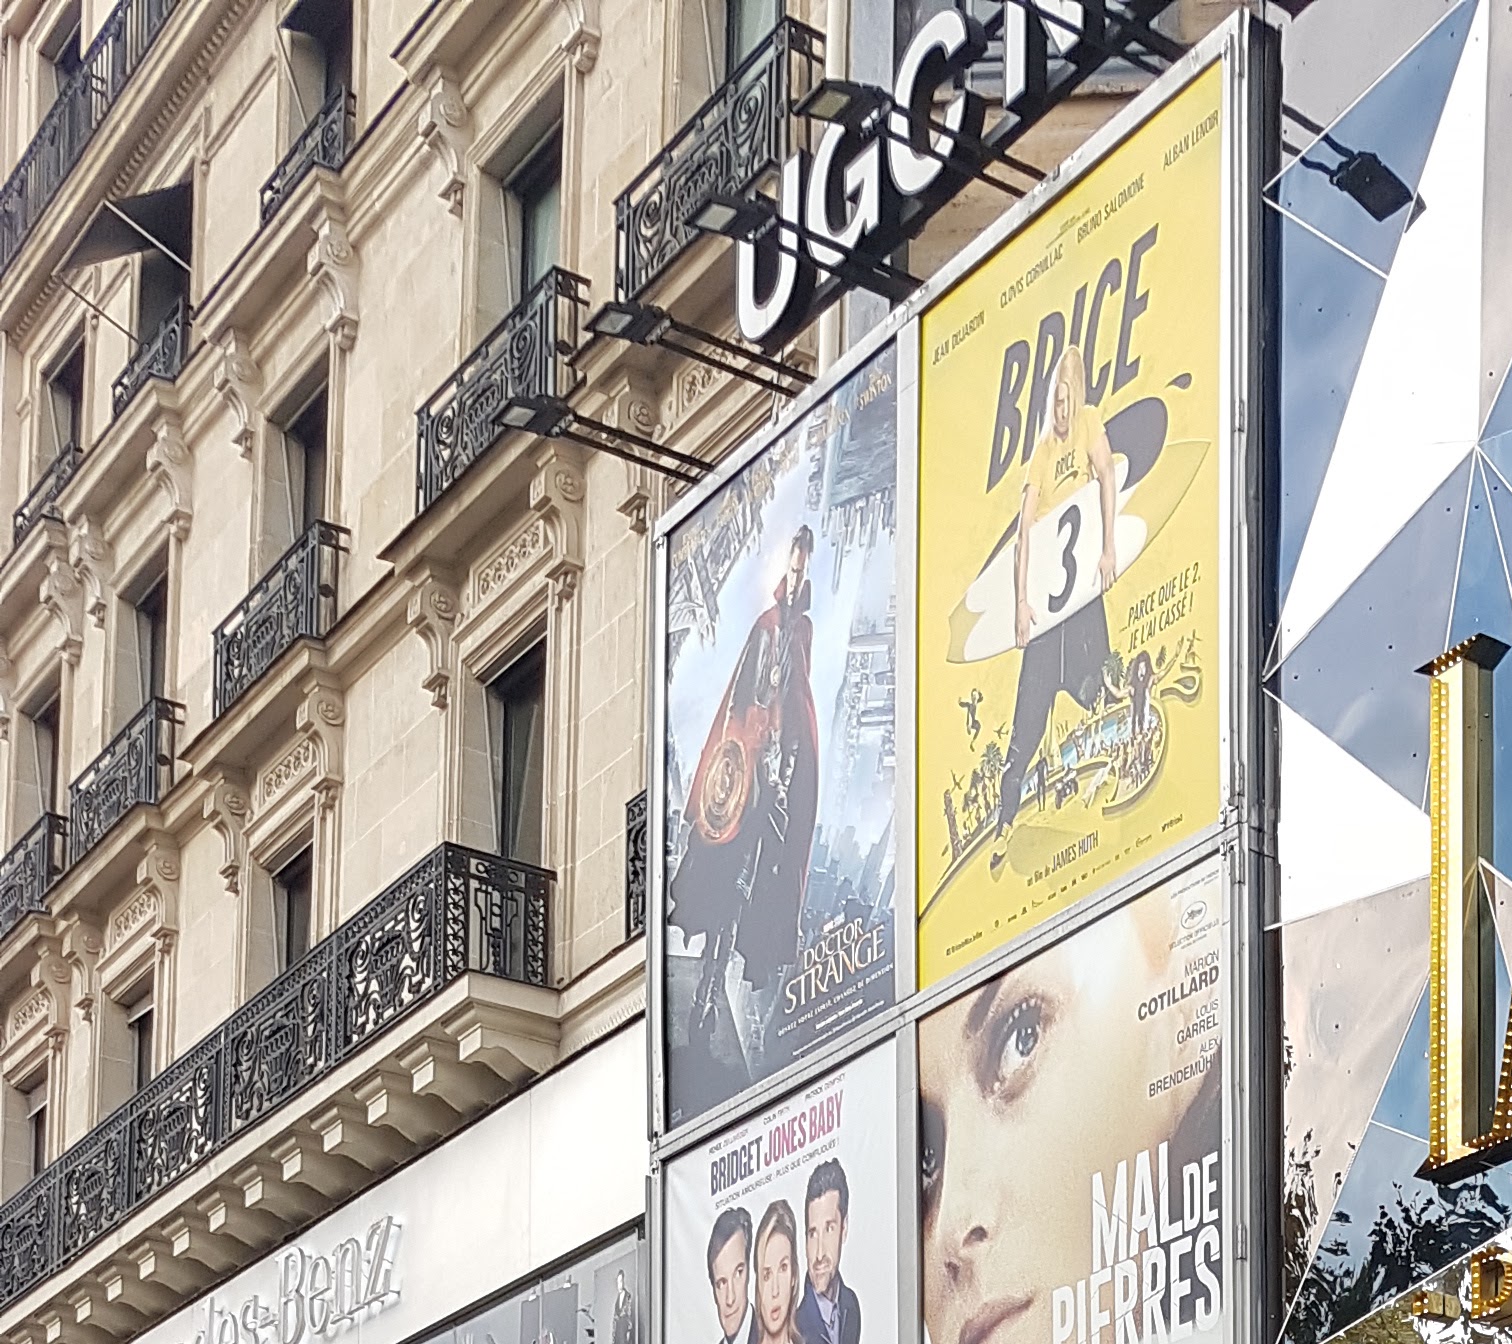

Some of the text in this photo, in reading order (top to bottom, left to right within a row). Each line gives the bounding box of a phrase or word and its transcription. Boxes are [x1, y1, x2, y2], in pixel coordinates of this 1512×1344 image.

[736, 9, 968, 342] UGC
[1163, 134, 1190, 171] ALBAN
[987, 222, 1160, 494] BRICE
[1054, 449, 1077, 481] BRICE
[1048, 504, 1082, 613] 3
[1158, 576, 1178, 607] QUE
[1179, 567, 1191, 593] LE
[1128, 628, 1140, 654] JE
[1051, 843, 1077, 873] JAMES
[1078, 830, 1099, 858] HUTH
[803, 917, 864, 971] DOCTOR
[1184, 949, 1220, 978] MARION
[784, 924, 886, 1015] STRANGE
[1138, 965, 1220, 1021] COTILLARD
[1176, 1013, 1219, 1045] GARREL
[1196, 998, 1219, 1019] LOUIS
[710, 1089, 844, 1197] BRIDGET JONES BABY
[1091, 1140, 1219, 1273] MAL DE
